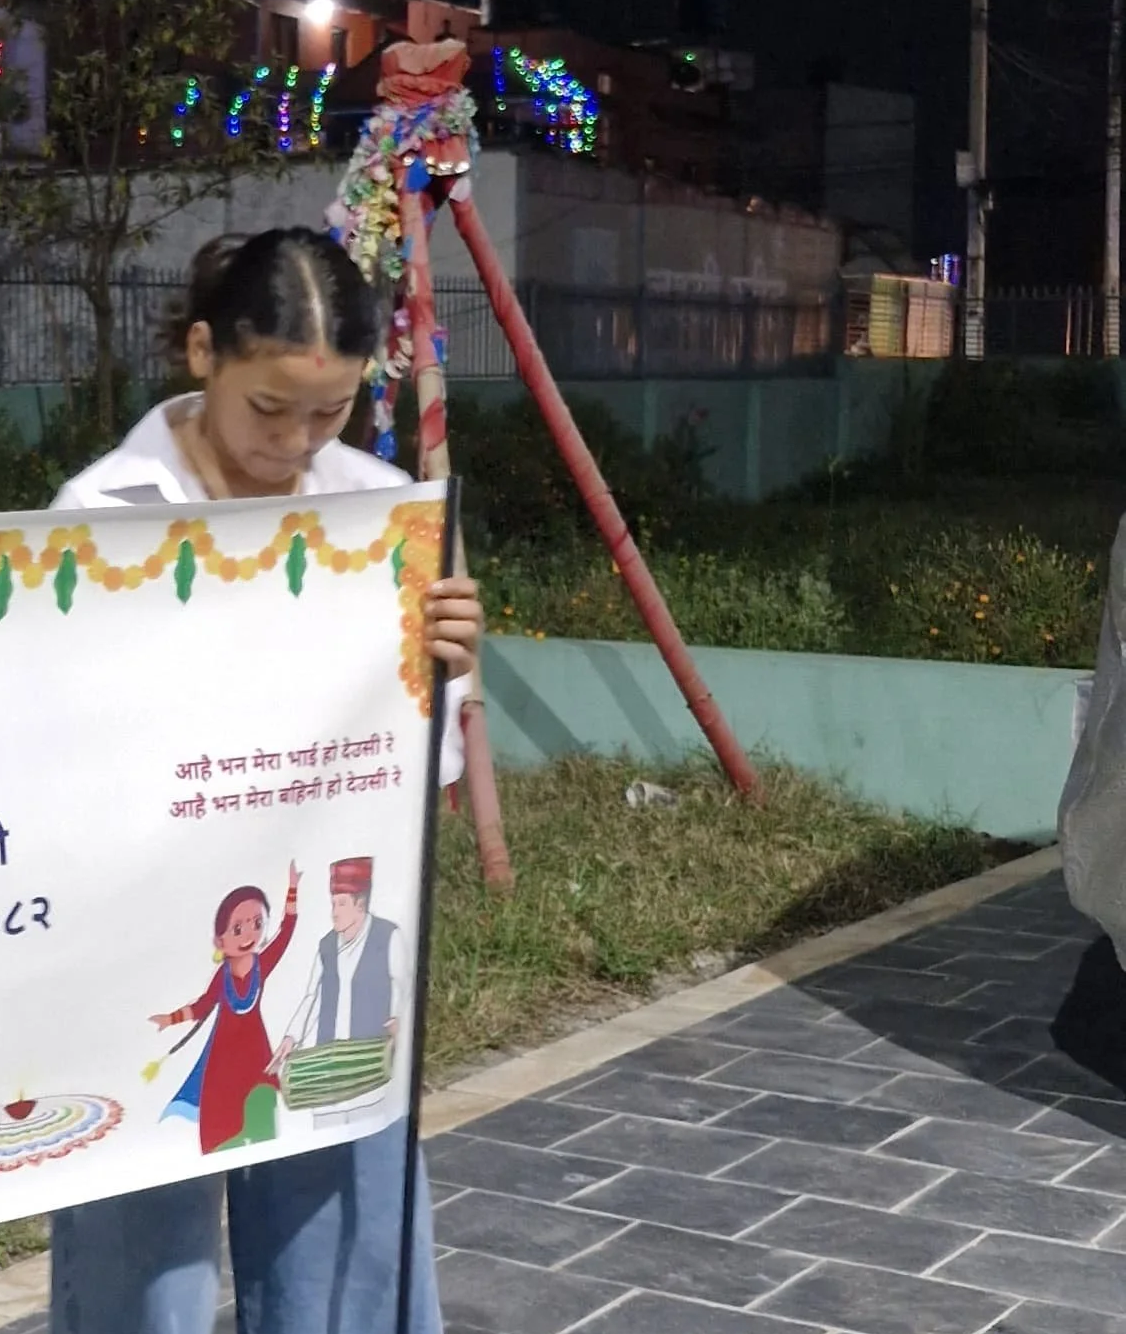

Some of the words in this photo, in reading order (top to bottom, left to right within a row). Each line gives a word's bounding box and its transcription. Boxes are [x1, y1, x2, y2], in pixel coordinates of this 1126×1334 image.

[175, 754, 212, 781] आहै
[216, 757, 247, 775] भन
[252, 748, 281, 770] मेरा
[287, 742, 318, 767] भाई
[320, 738, 337, 766] हो
[341, 733, 380, 760] देउसी
[385, 731, 394, 753] रे
[169, 792, 207, 819] आहै
[211, 794, 240, 813] भन
[245, 786, 274, 809] मेरा
[278, 776, 323, 806] बहिनी
[325, 773, 342, 800] हो
[345, 766, 387, 792] देउसी
[391, 765, 402, 787] रे
